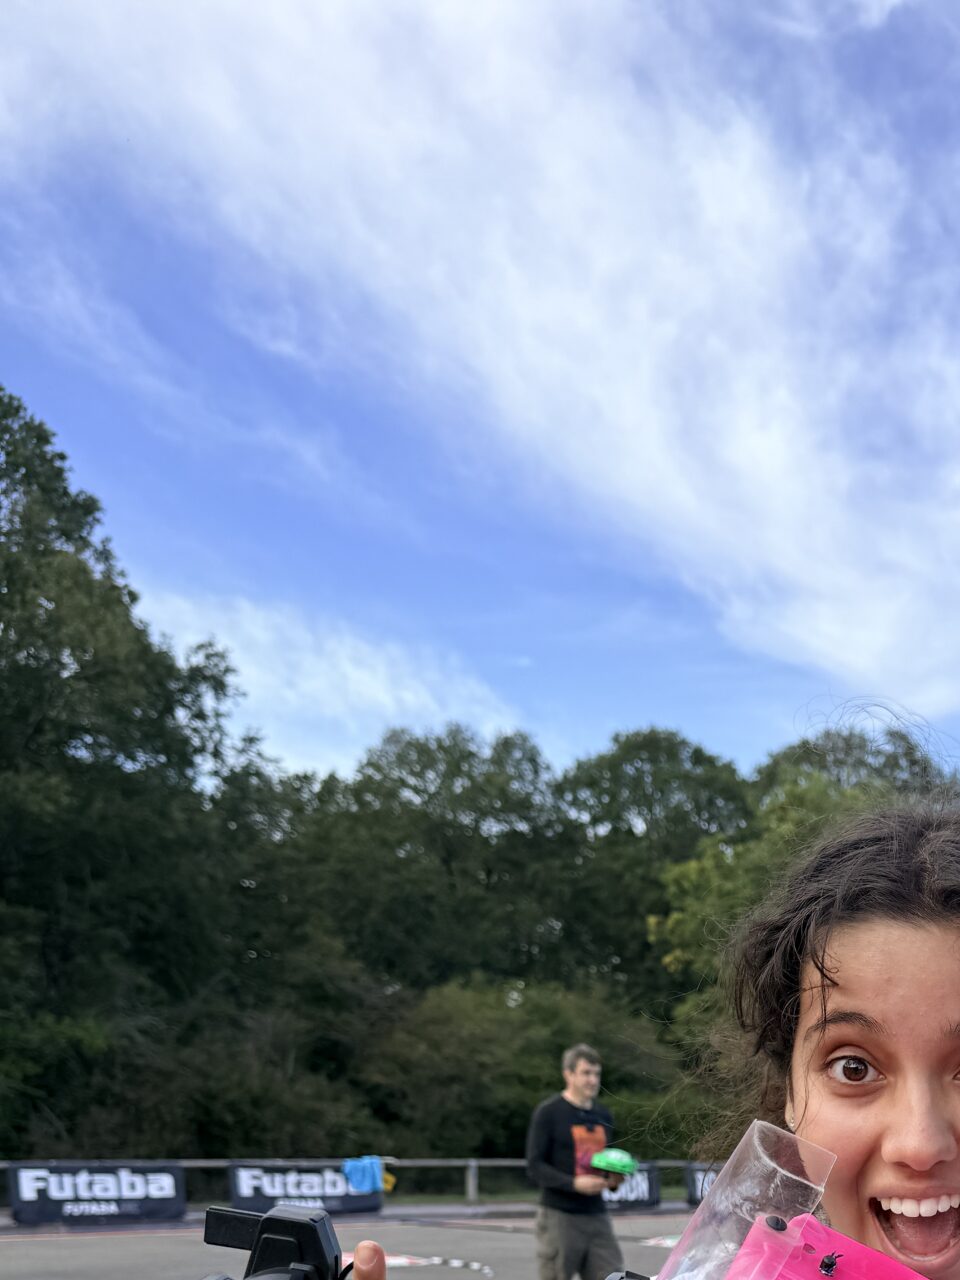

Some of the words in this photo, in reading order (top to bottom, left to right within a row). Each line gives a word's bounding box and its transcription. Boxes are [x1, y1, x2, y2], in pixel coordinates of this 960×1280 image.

[18, 1168, 176, 1201] Futaba
[237, 1168, 372, 1197] Futab
[62, 1201, 119, 1216] FUTABA
